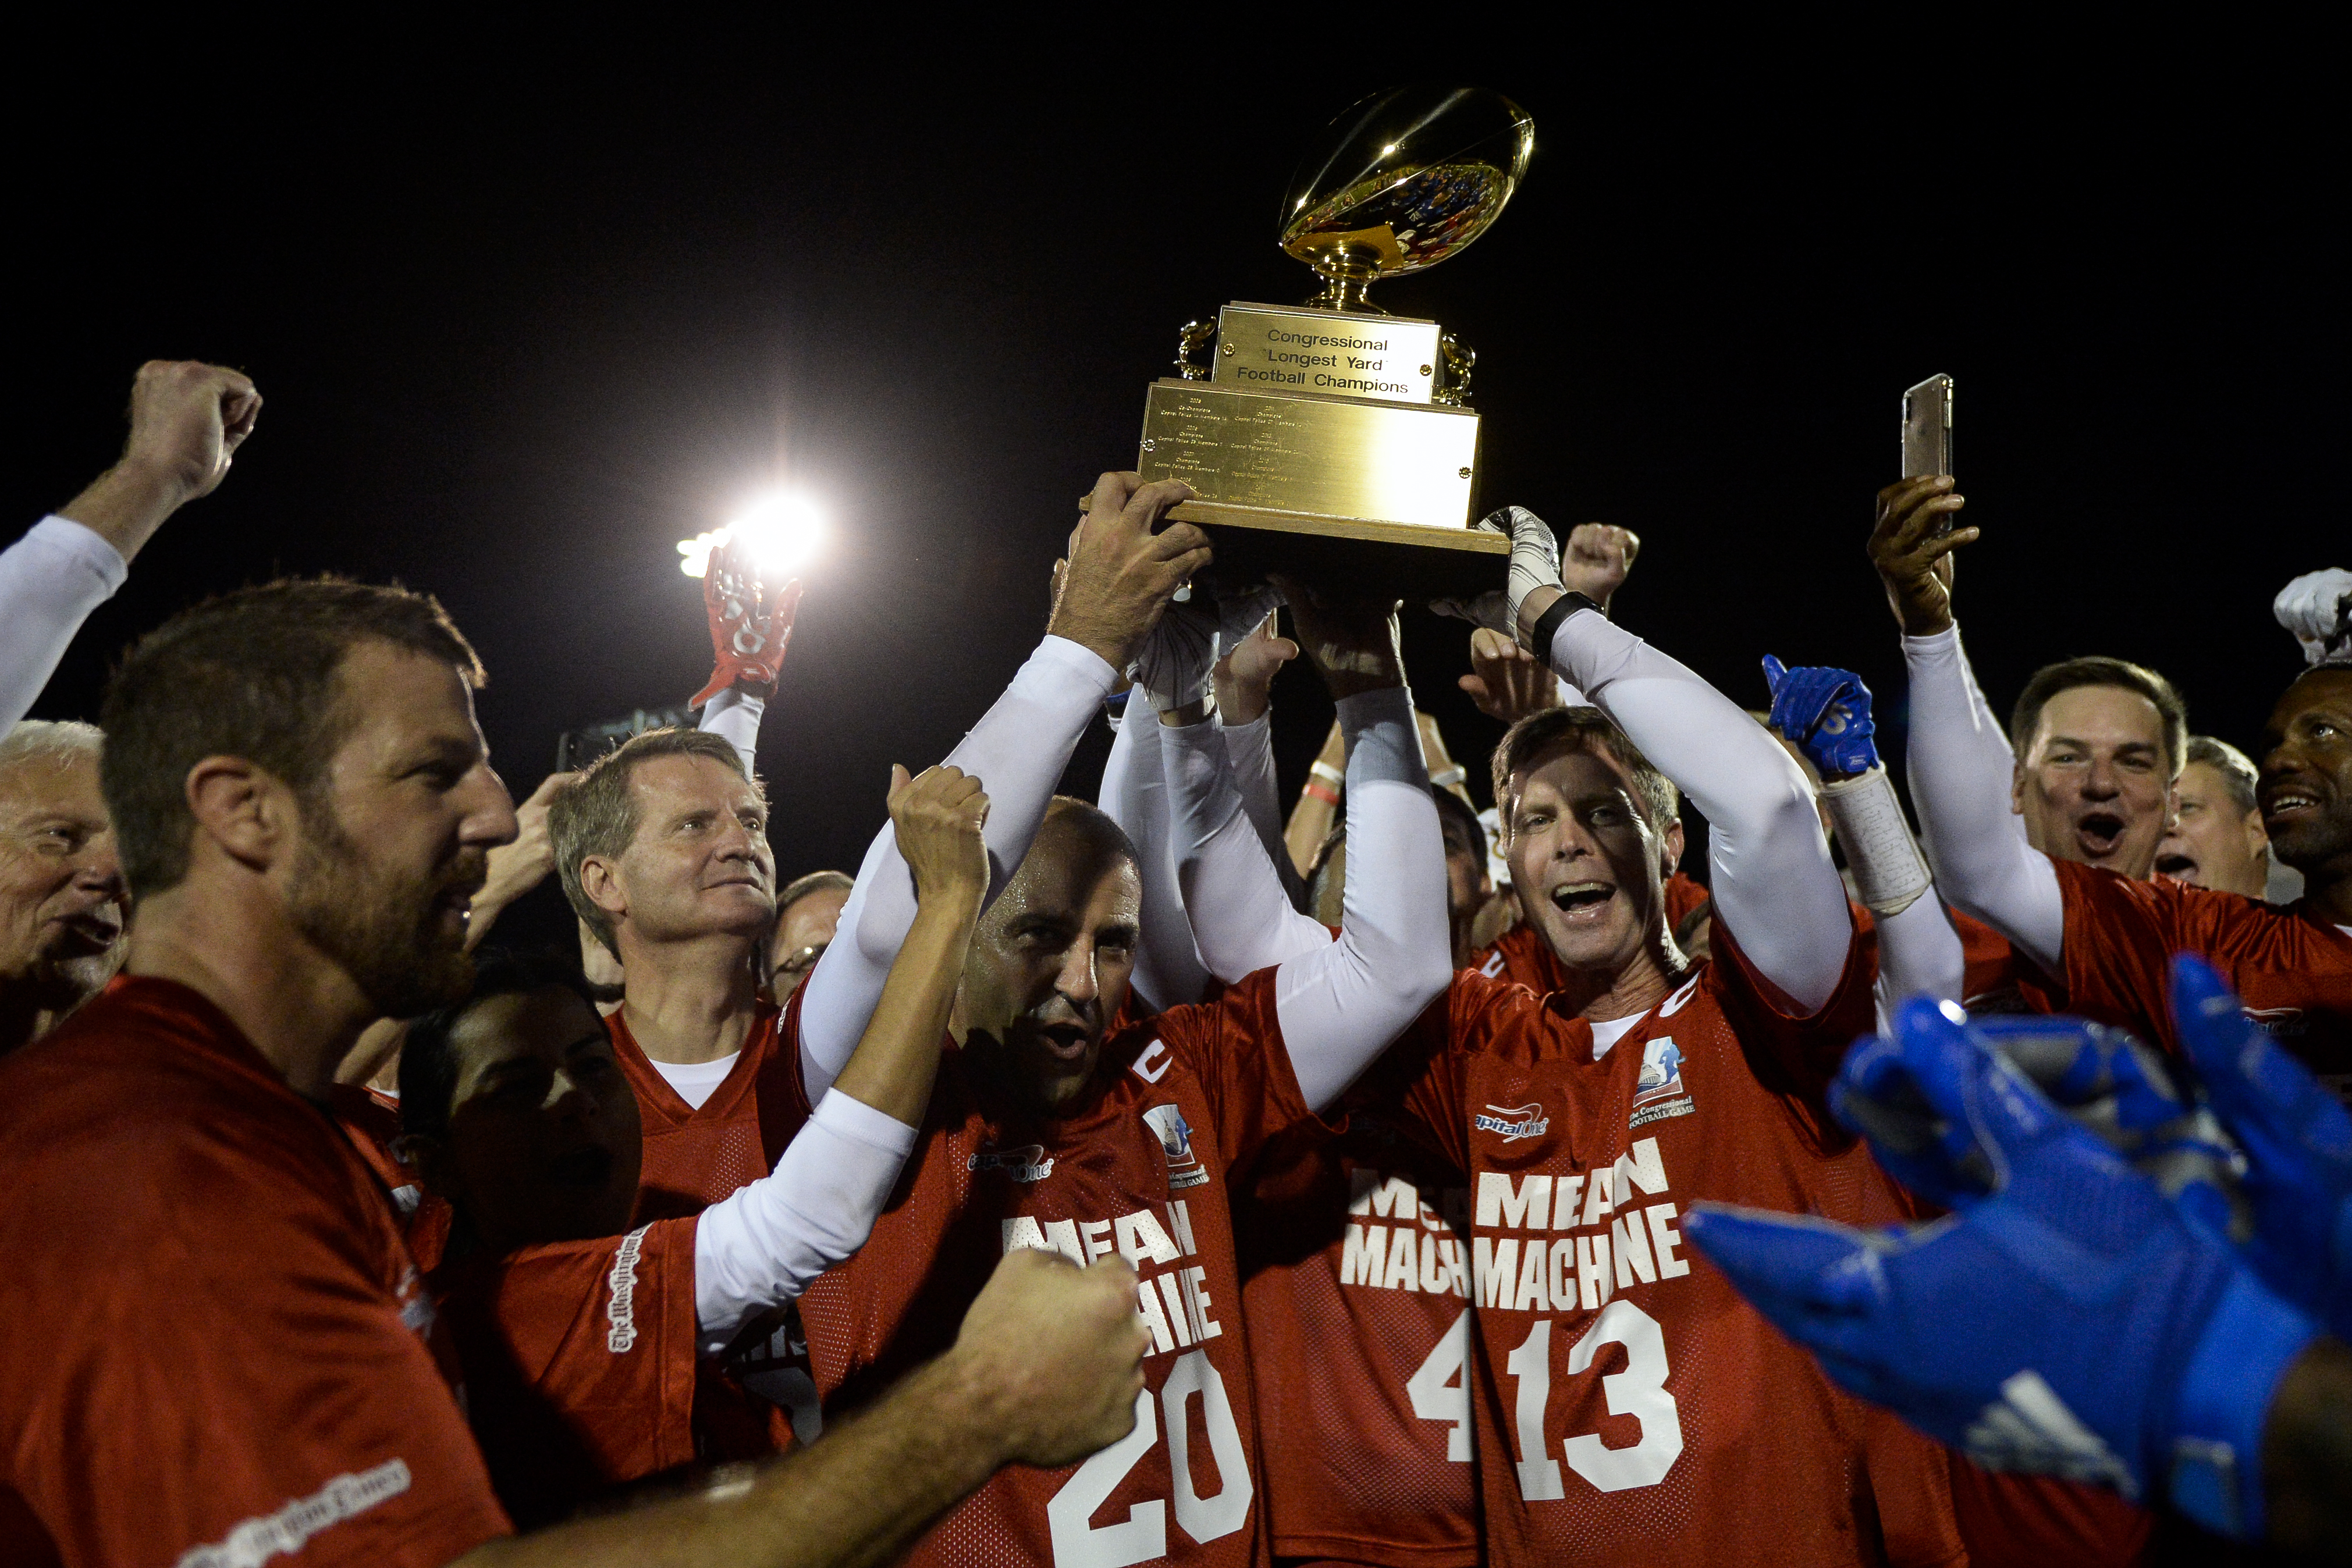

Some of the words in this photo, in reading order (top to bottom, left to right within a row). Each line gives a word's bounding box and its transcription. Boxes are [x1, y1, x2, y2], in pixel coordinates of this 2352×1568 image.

[1267, 329, 1388, 351] Congressional
[1268, 350, 1337, 368] Longest
[1346, 355, 1382, 371] Yard
[1237, 367, 1305, 385] Football
[1314, 374, 1408, 393] Champions
[1629, 1111, 1669, 1129] FOOTBALL
[1669, 1105, 1696, 1116] GAME
[1640, 1095, 1692, 1116] Congressional
[1476, 1137, 1669, 1230] MEAN
[1473, 1202, 1690, 1312] MACHNE
[1507, 1299, 1683, 1501] 13
[1047, 1349, 1253, 1568] 20
